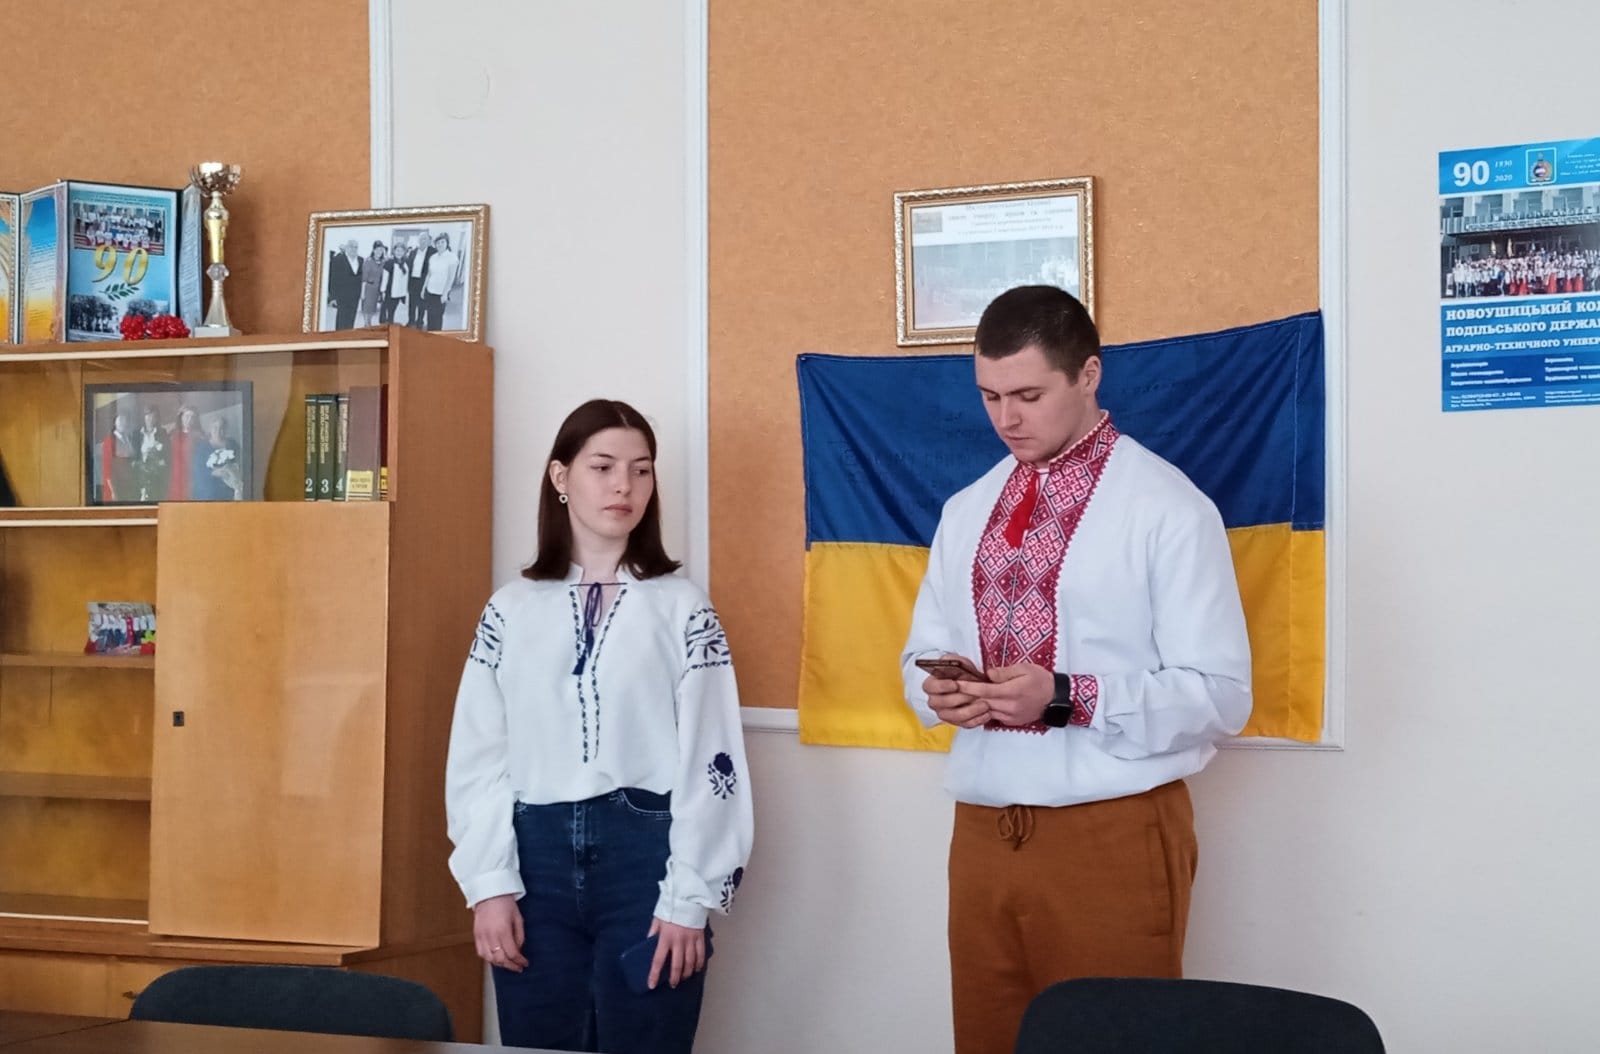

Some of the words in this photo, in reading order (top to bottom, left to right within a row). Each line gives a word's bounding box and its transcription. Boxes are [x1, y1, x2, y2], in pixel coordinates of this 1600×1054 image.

[1452, 160, 1491, 187] 90
[92, 244, 149, 286] 90
[1446, 300, 1572, 321] НОВОУШИЦЬКИЙ
[1446, 322, 1547, 338] ПОДІЛЬСЬКОГО
[305, 478, 313, 492] 2
[321, 479, 329, 493] 3
[335, 478, 343, 492] 4
